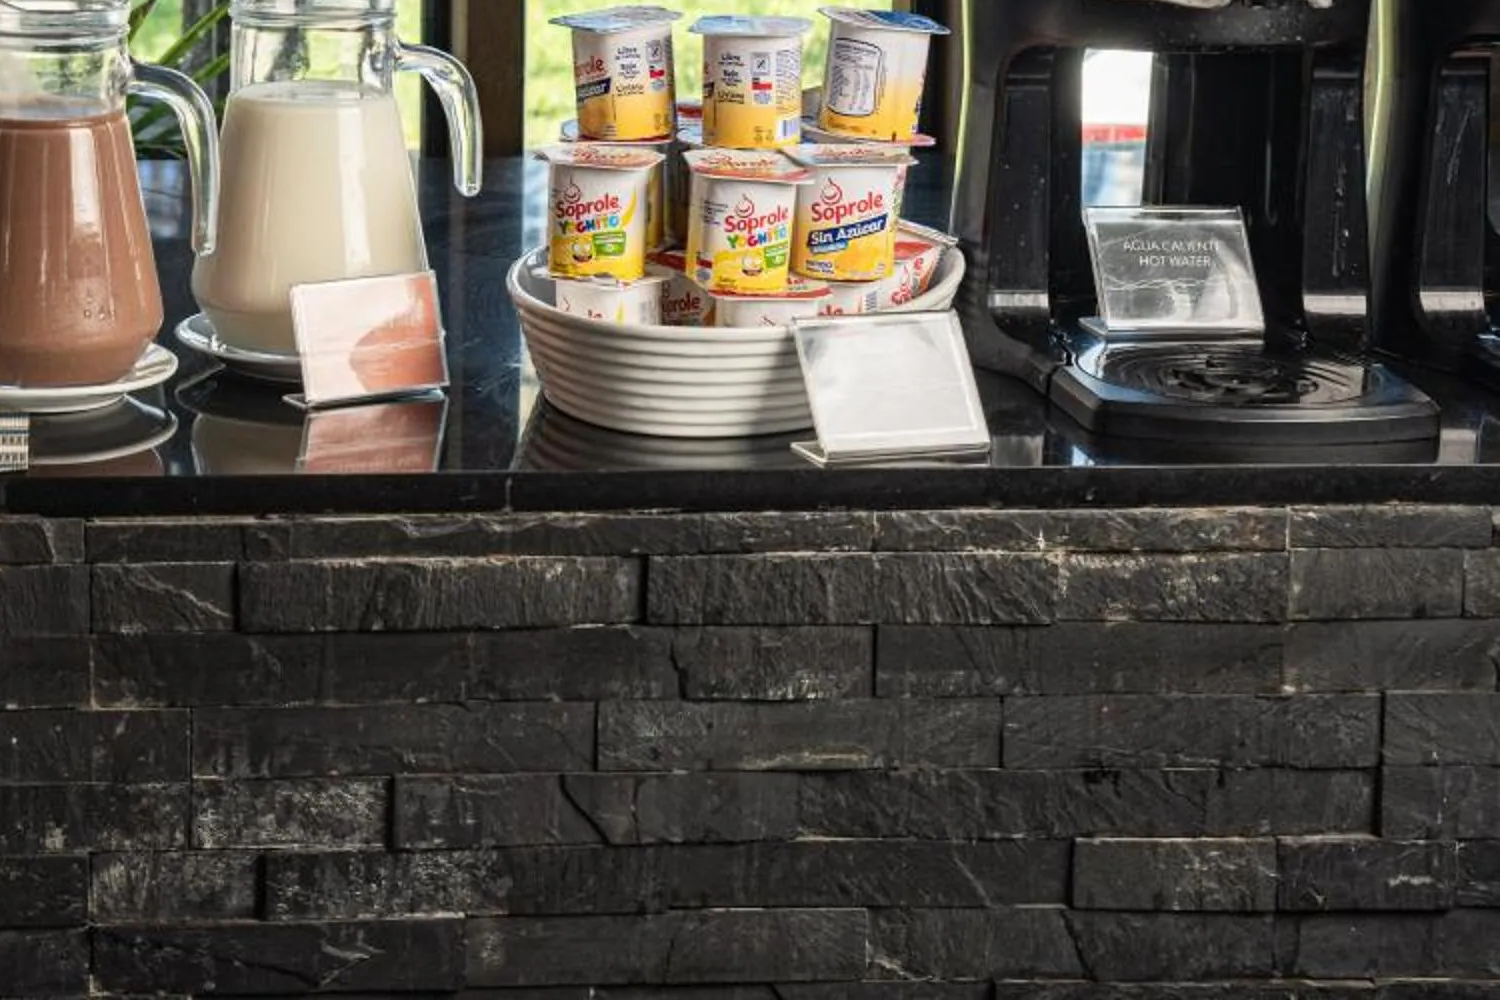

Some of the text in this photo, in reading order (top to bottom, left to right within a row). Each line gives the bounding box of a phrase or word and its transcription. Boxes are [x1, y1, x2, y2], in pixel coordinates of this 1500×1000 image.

[555, 192, 619, 220] Soprole
[724, 205, 789, 234] Soprole
[811, 191, 884, 224] Soprole
[810, 230, 833, 246] Sin
[1139, 255, 1211, 268] HOT WATER
